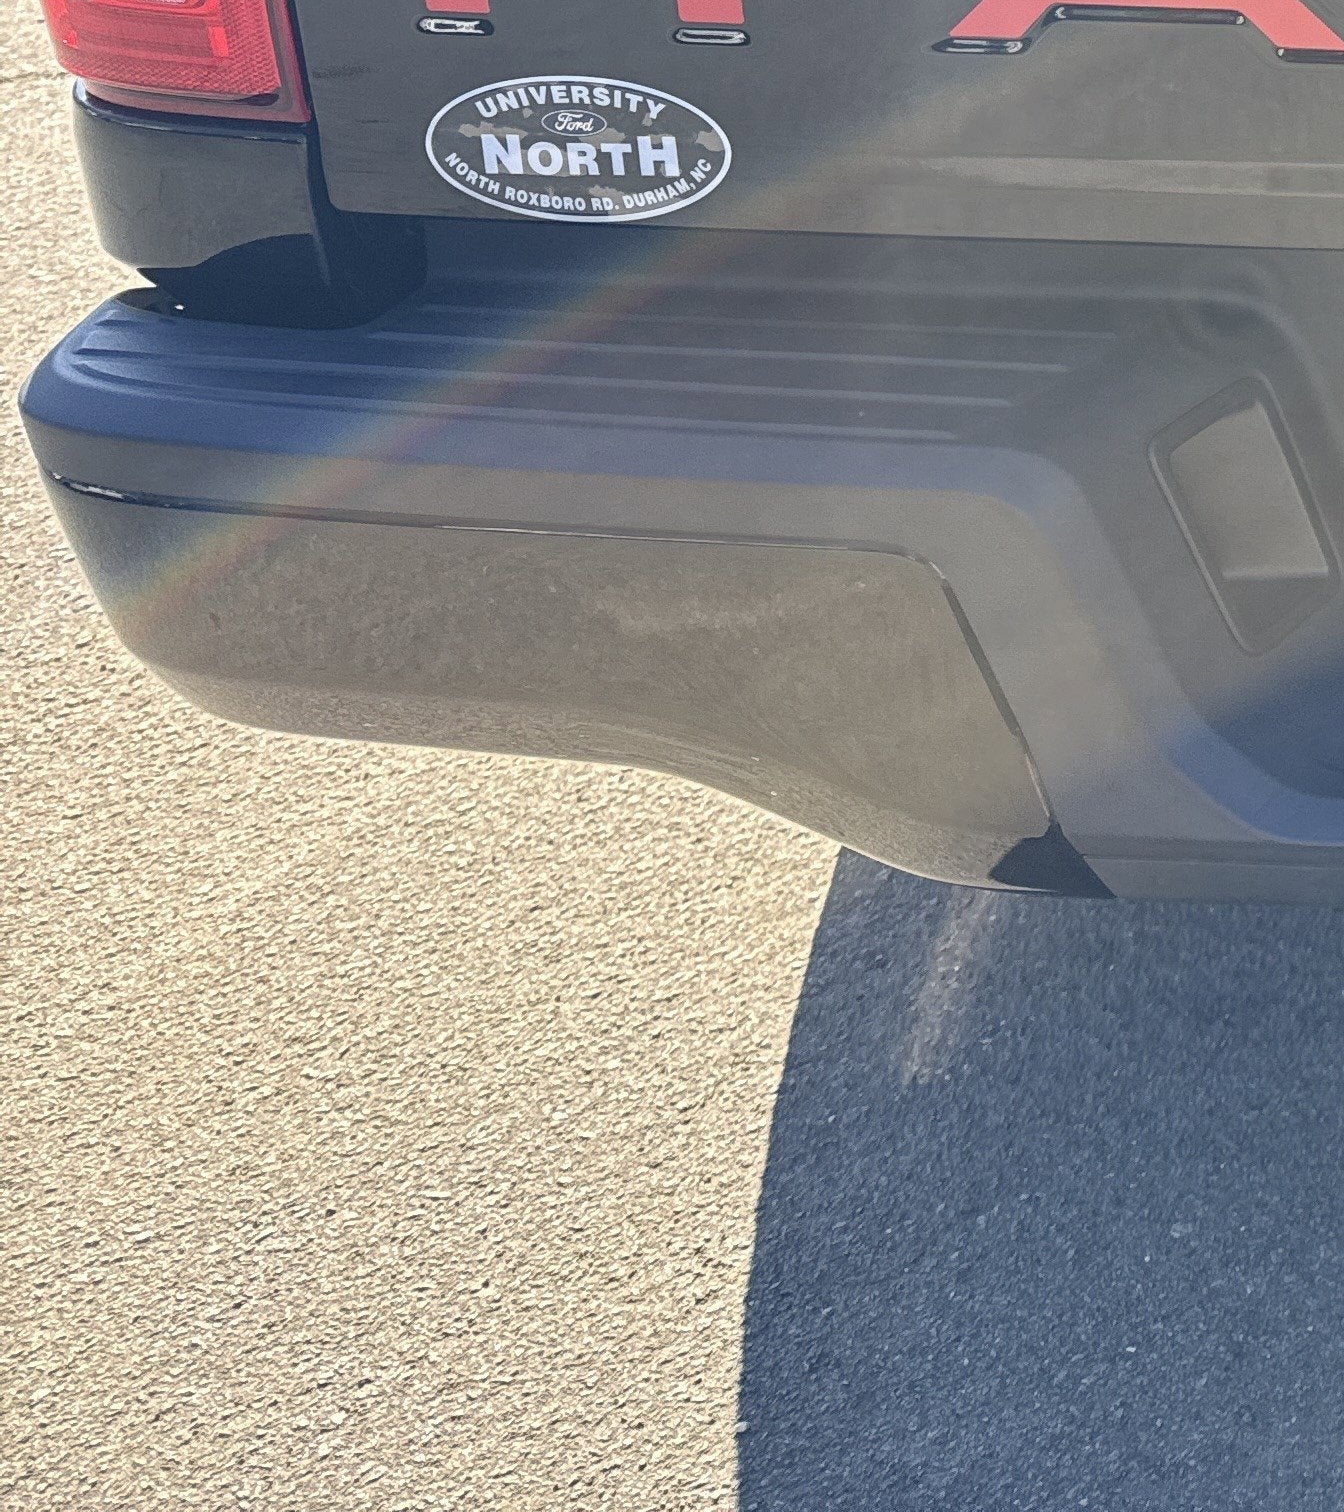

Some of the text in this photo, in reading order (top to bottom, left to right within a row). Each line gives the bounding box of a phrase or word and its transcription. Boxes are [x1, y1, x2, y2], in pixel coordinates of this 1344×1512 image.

[474, 85, 666, 120] UNIVERSITY
[554, 112, 595, 133] Ford
[444, 152, 712, 212] NORTH ROXBORO RD. DURHAM, NC
